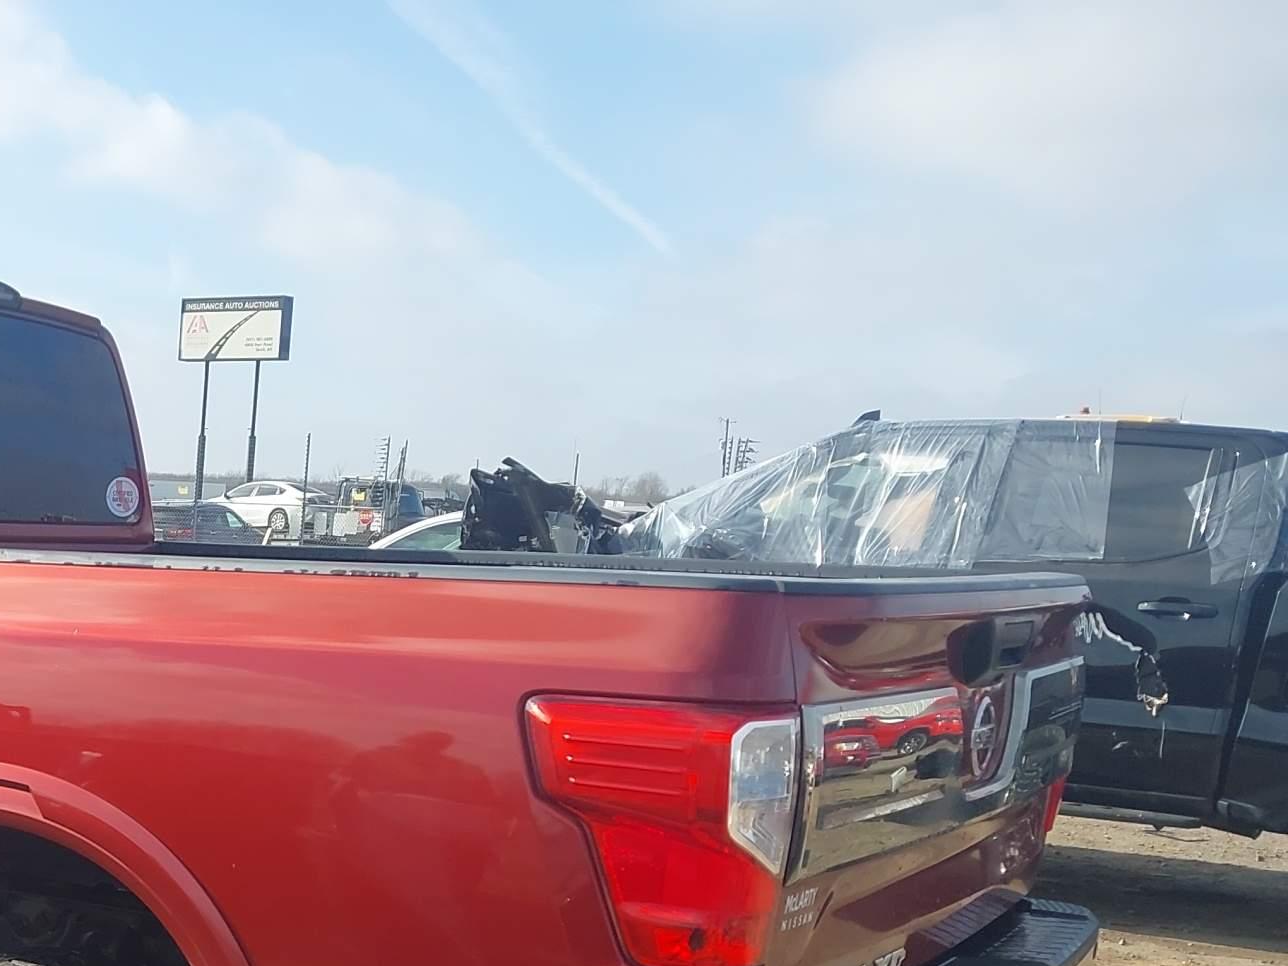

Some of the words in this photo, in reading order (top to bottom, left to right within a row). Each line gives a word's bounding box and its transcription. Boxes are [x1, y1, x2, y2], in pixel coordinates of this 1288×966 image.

[185, 302, 224, 311] INSURANCE
[225, 301, 244, 310] AUTO
[245, 300, 280, 309] AUCTIONS
[781, 911, 814, 931] NISSAN
